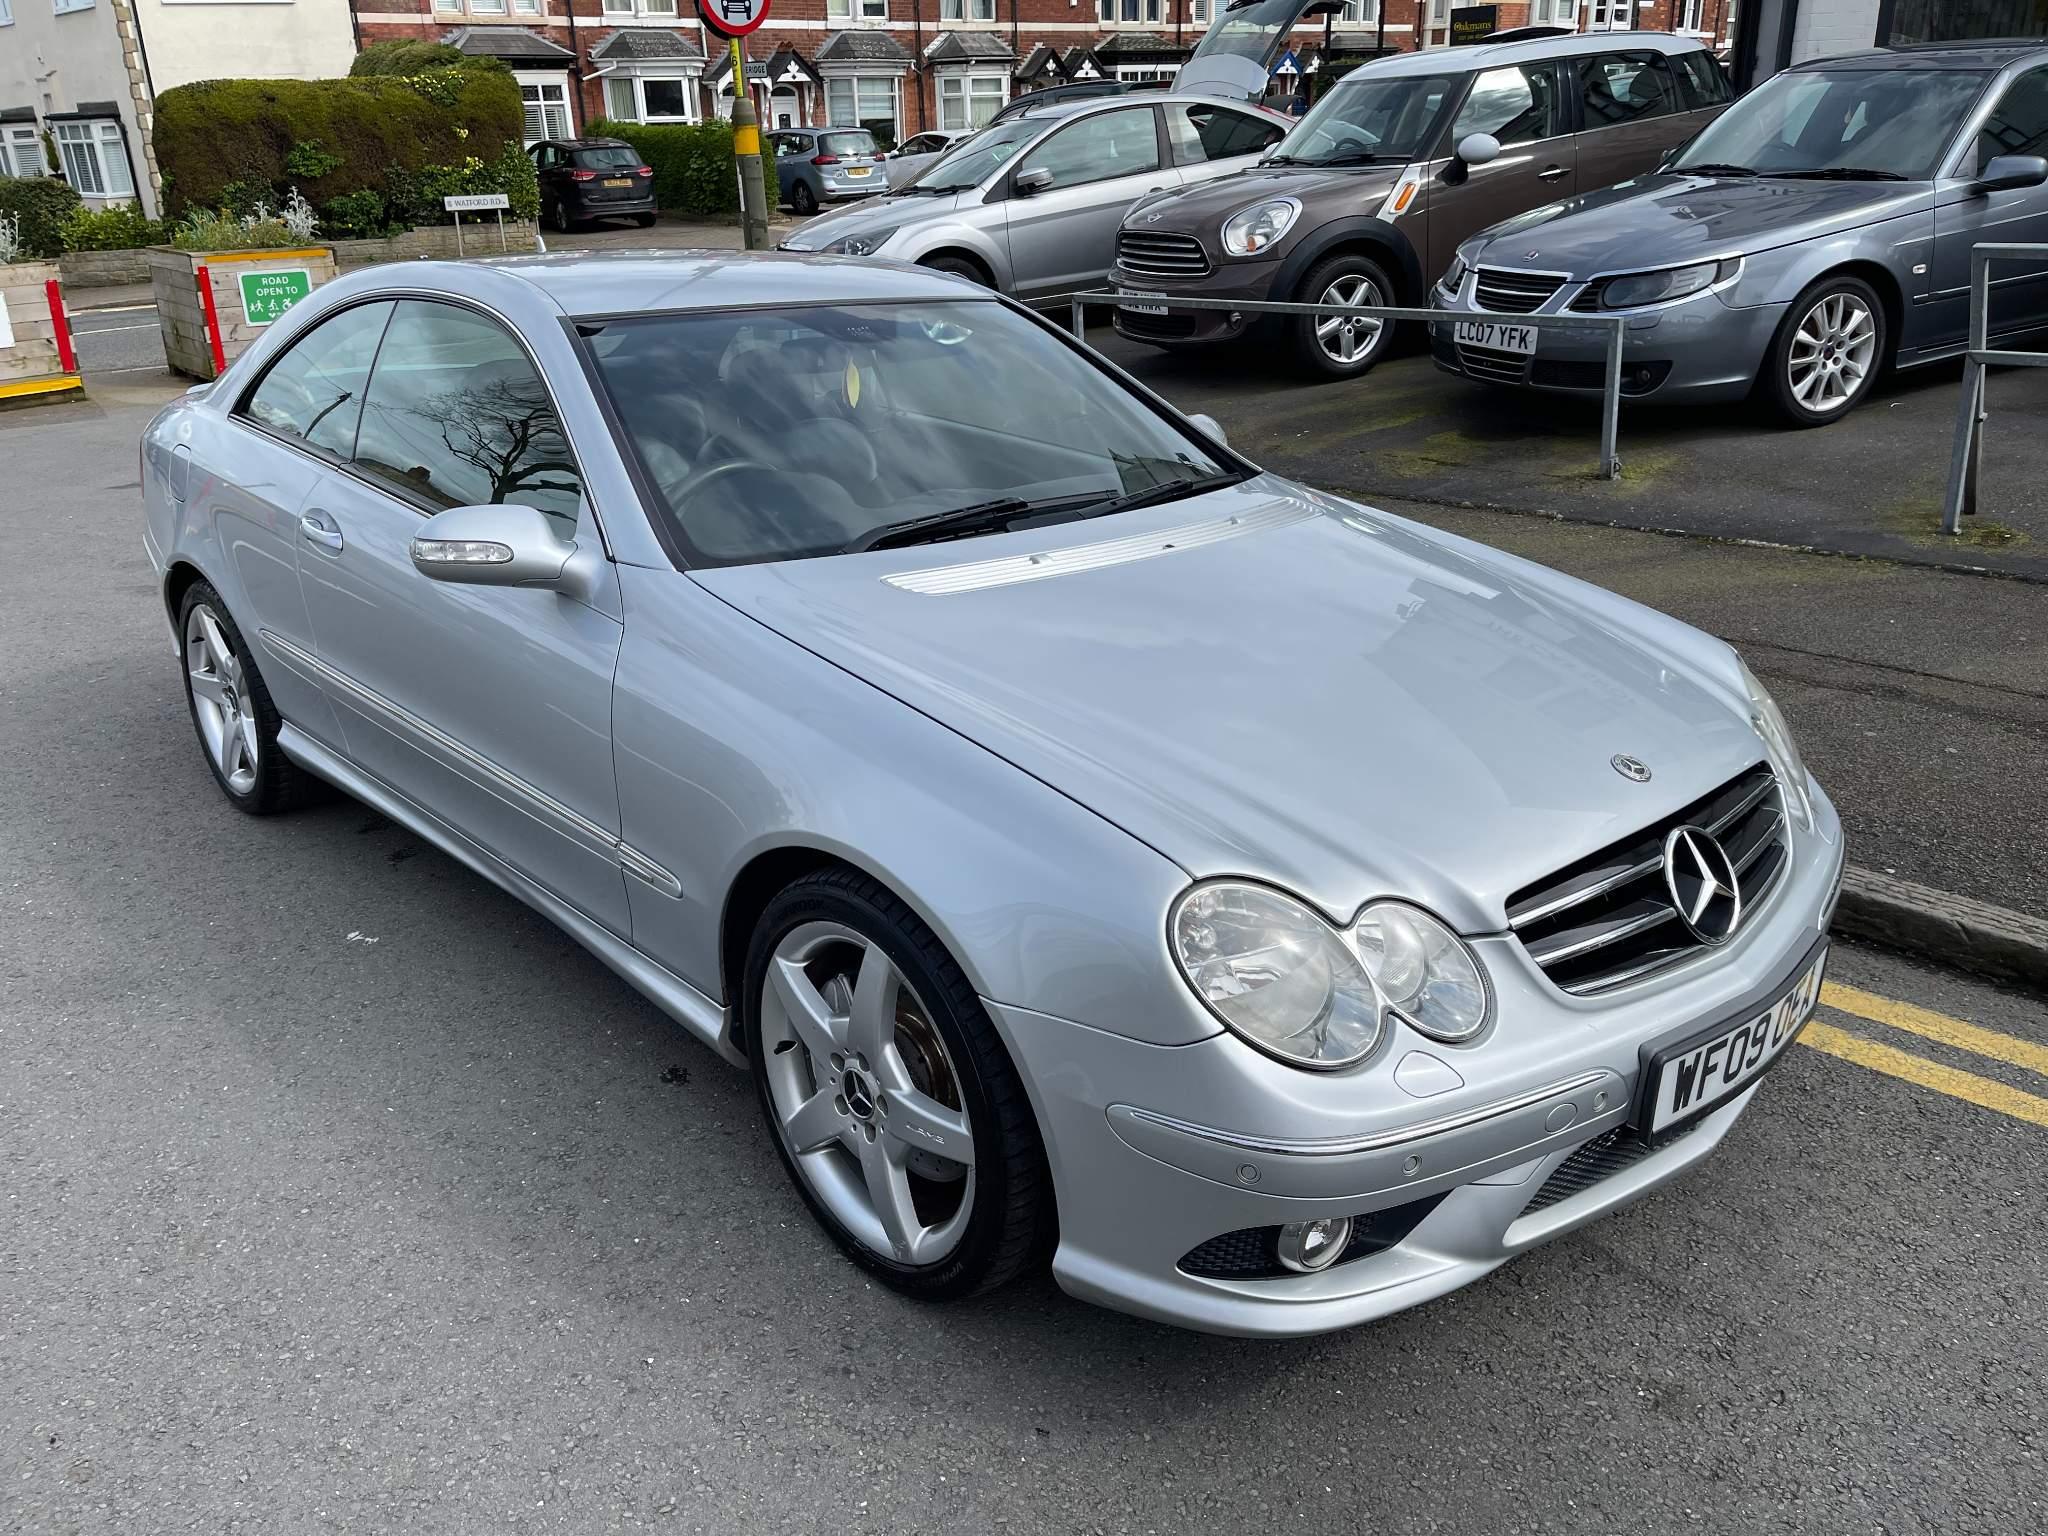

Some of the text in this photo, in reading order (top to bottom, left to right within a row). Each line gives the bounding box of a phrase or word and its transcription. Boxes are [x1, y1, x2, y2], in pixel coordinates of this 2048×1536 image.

[454, 199, 488, 207] WATFORD
[261, 276, 289, 285] ROAD
[256, 286, 298, 297] OPEN TO
[1459, 321, 1530, 350] LC07 YFK
[1672, 1012, 1772, 1114] WF09
